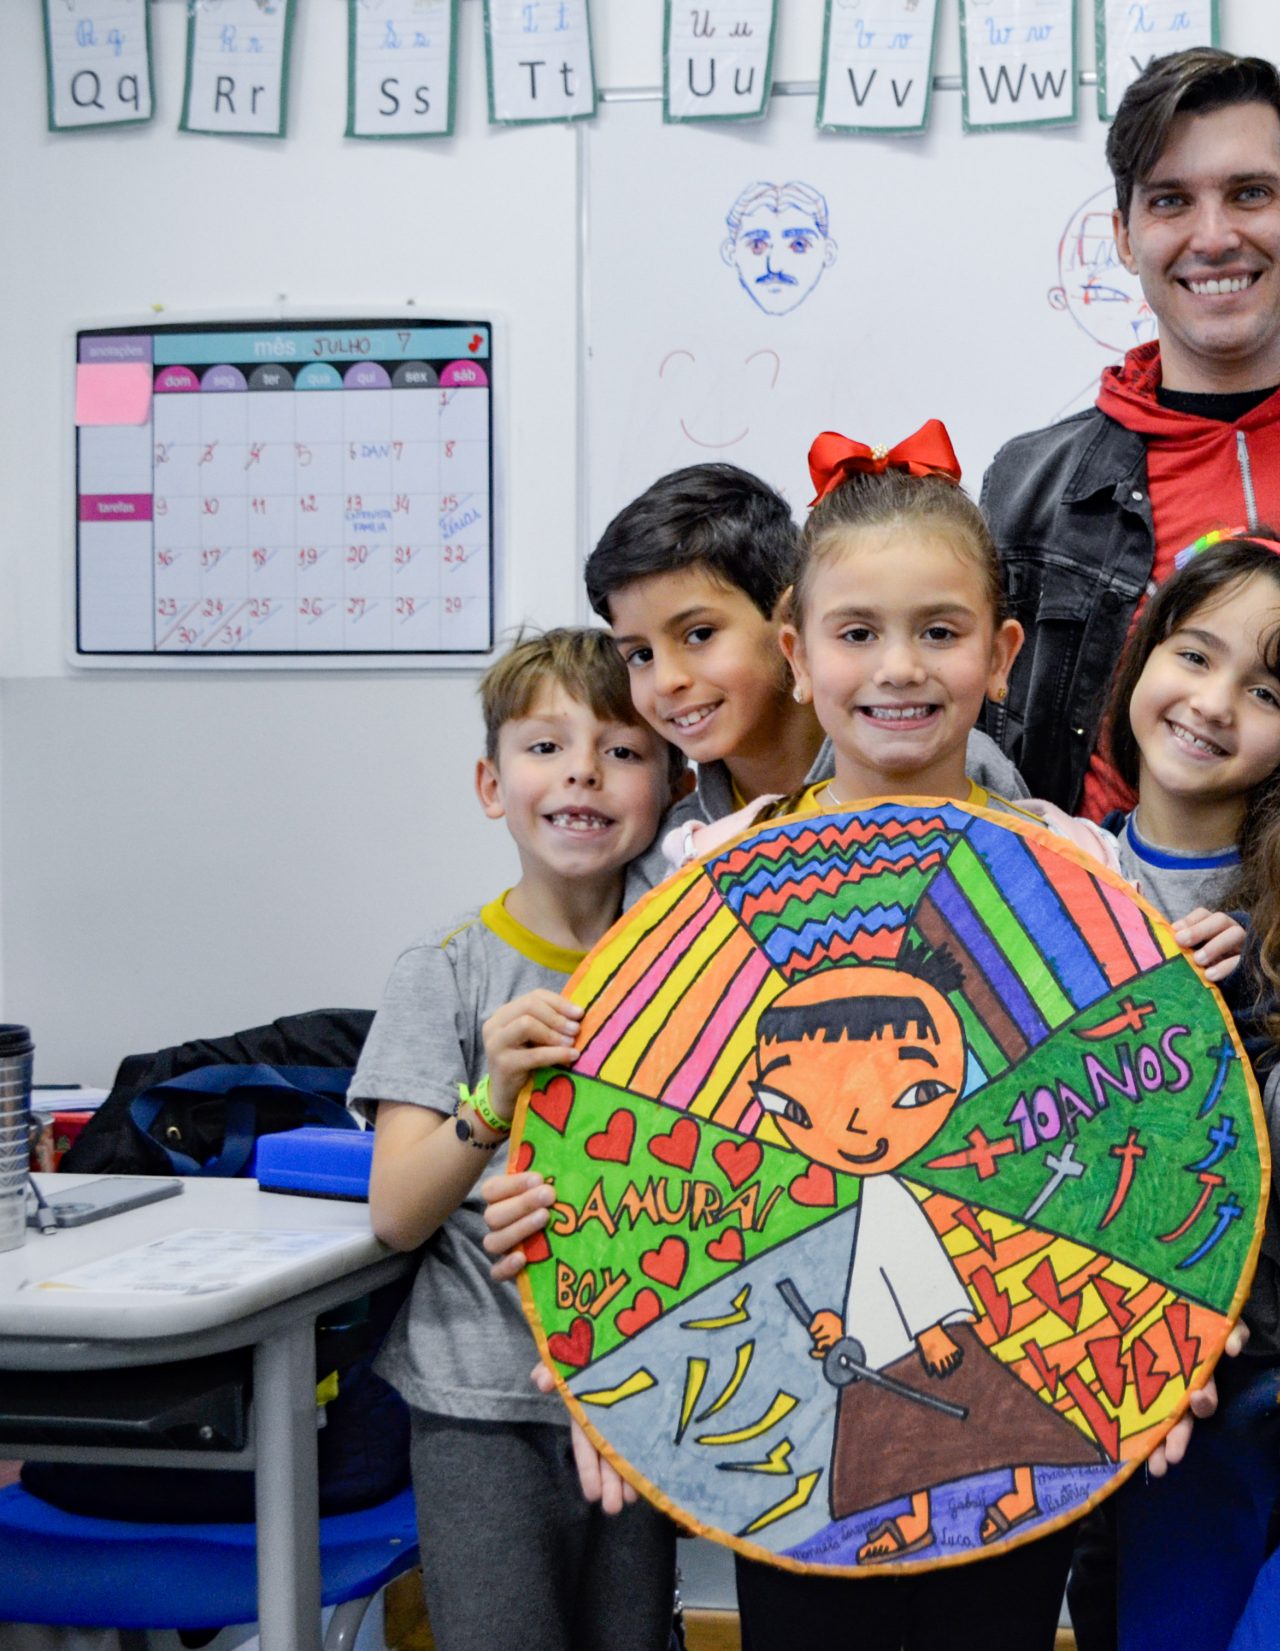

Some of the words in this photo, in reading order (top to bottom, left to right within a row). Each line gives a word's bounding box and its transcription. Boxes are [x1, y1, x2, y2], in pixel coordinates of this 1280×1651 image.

[313, 337, 371, 357] JULHO
[164, 374, 191, 386] dom
[262, 373, 280, 386] ter
[405, 371, 428, 383] sex
[556, 1257, 632, 1320] BOY
